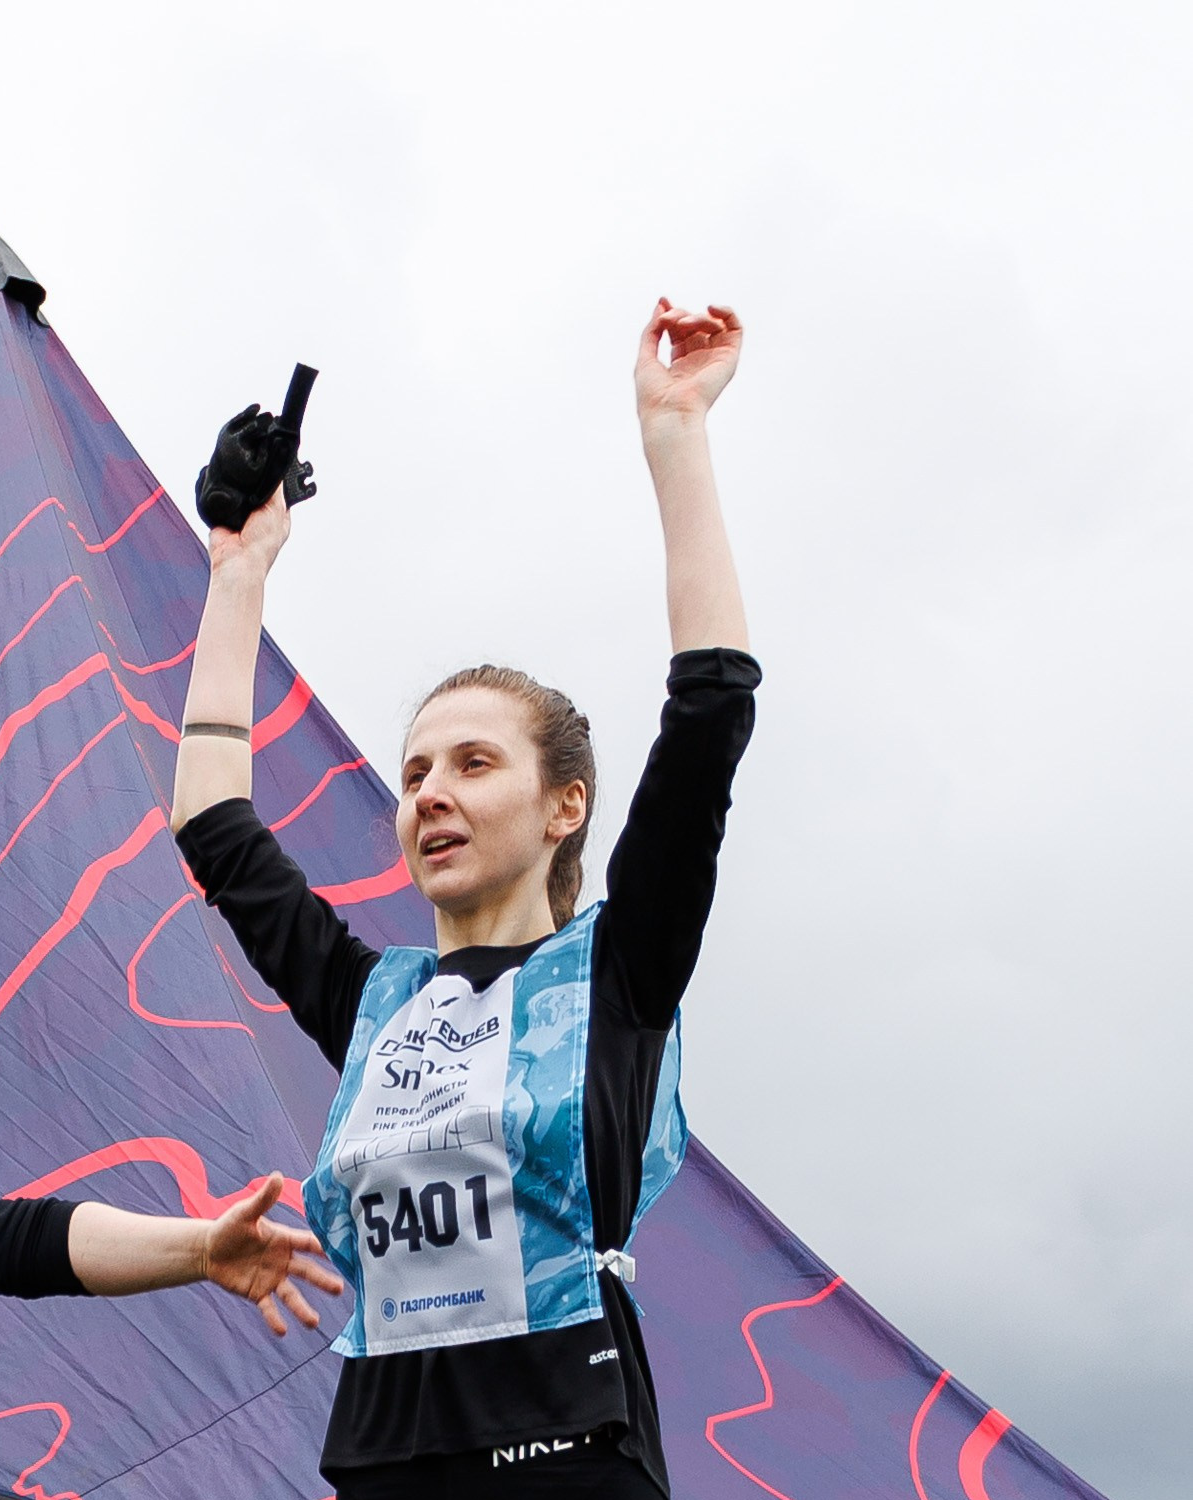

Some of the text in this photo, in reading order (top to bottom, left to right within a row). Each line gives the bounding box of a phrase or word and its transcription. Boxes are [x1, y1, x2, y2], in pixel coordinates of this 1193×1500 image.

[372, 1122, 397, 1131] FINE
[358, 1174, 493, 1259] 5401
[400, 1289, 486, 1314] ГАЗПРОМБАНК
